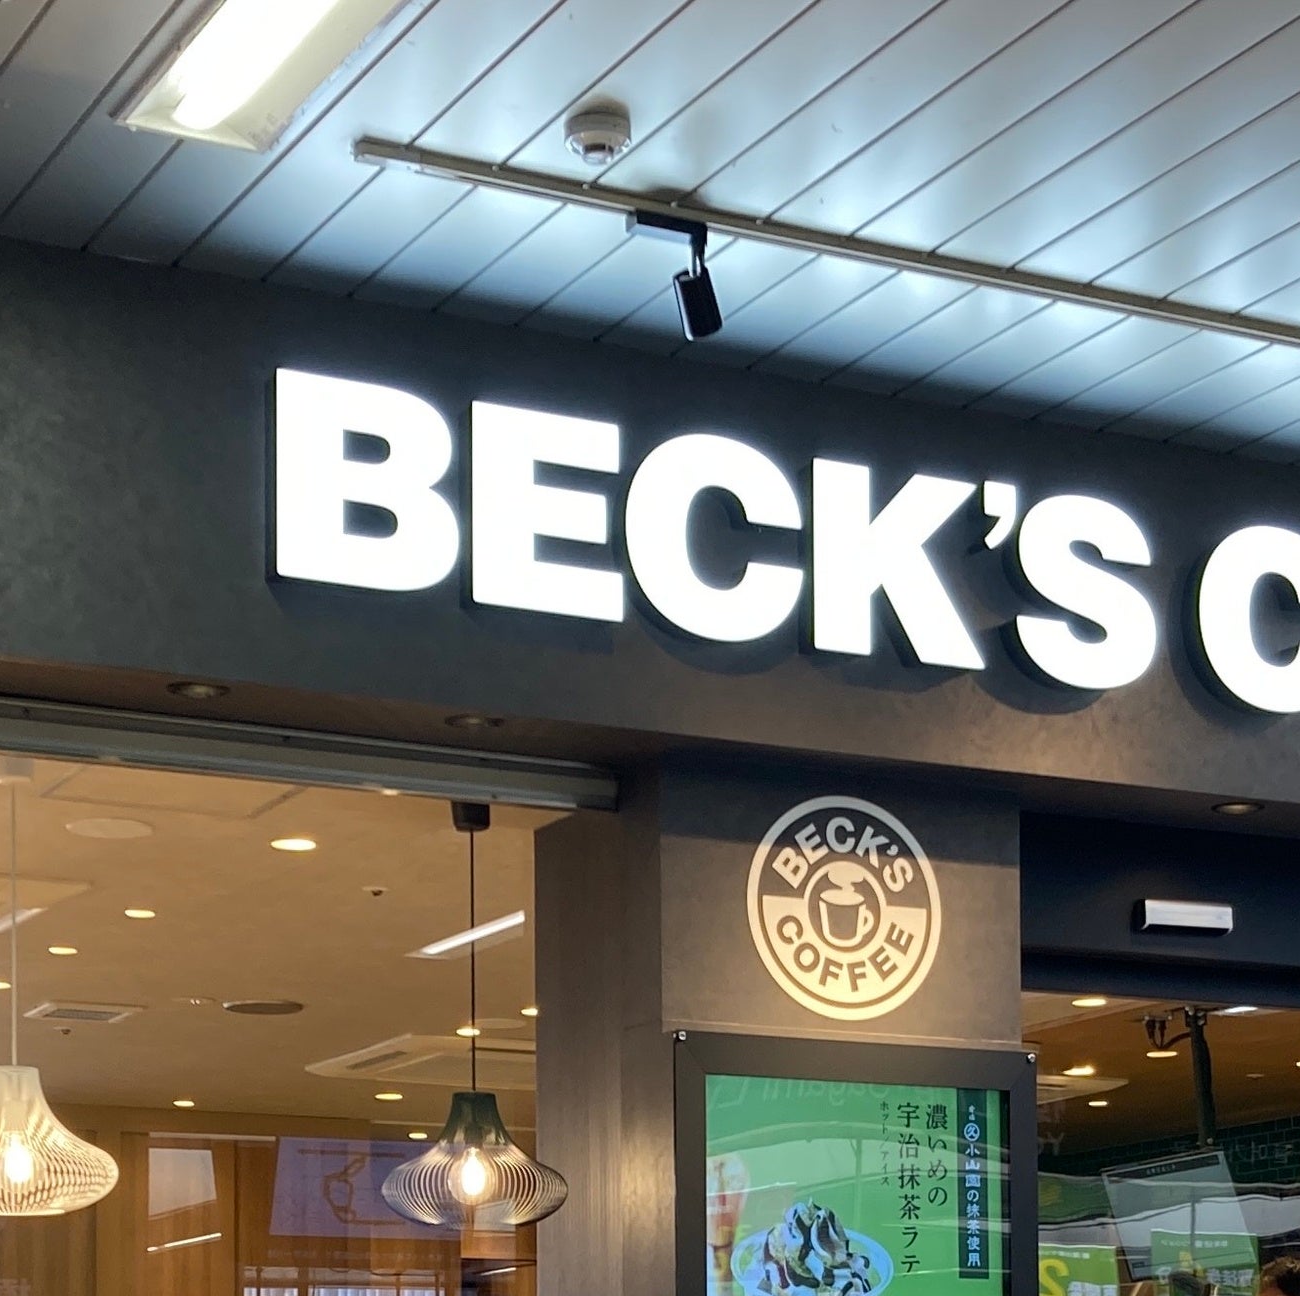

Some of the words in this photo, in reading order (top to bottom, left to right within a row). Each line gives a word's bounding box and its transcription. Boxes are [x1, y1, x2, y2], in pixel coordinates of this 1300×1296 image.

[275, 367, 1158, 690] BECK'S
[772, 816, 915, 893] BECK'S
[776, 914, 915, 993] COFFEE
[896, 1102, 921, 1277] 宇治抹茶ラテ
[925, 1103, 948, 1207] 濃いめの
